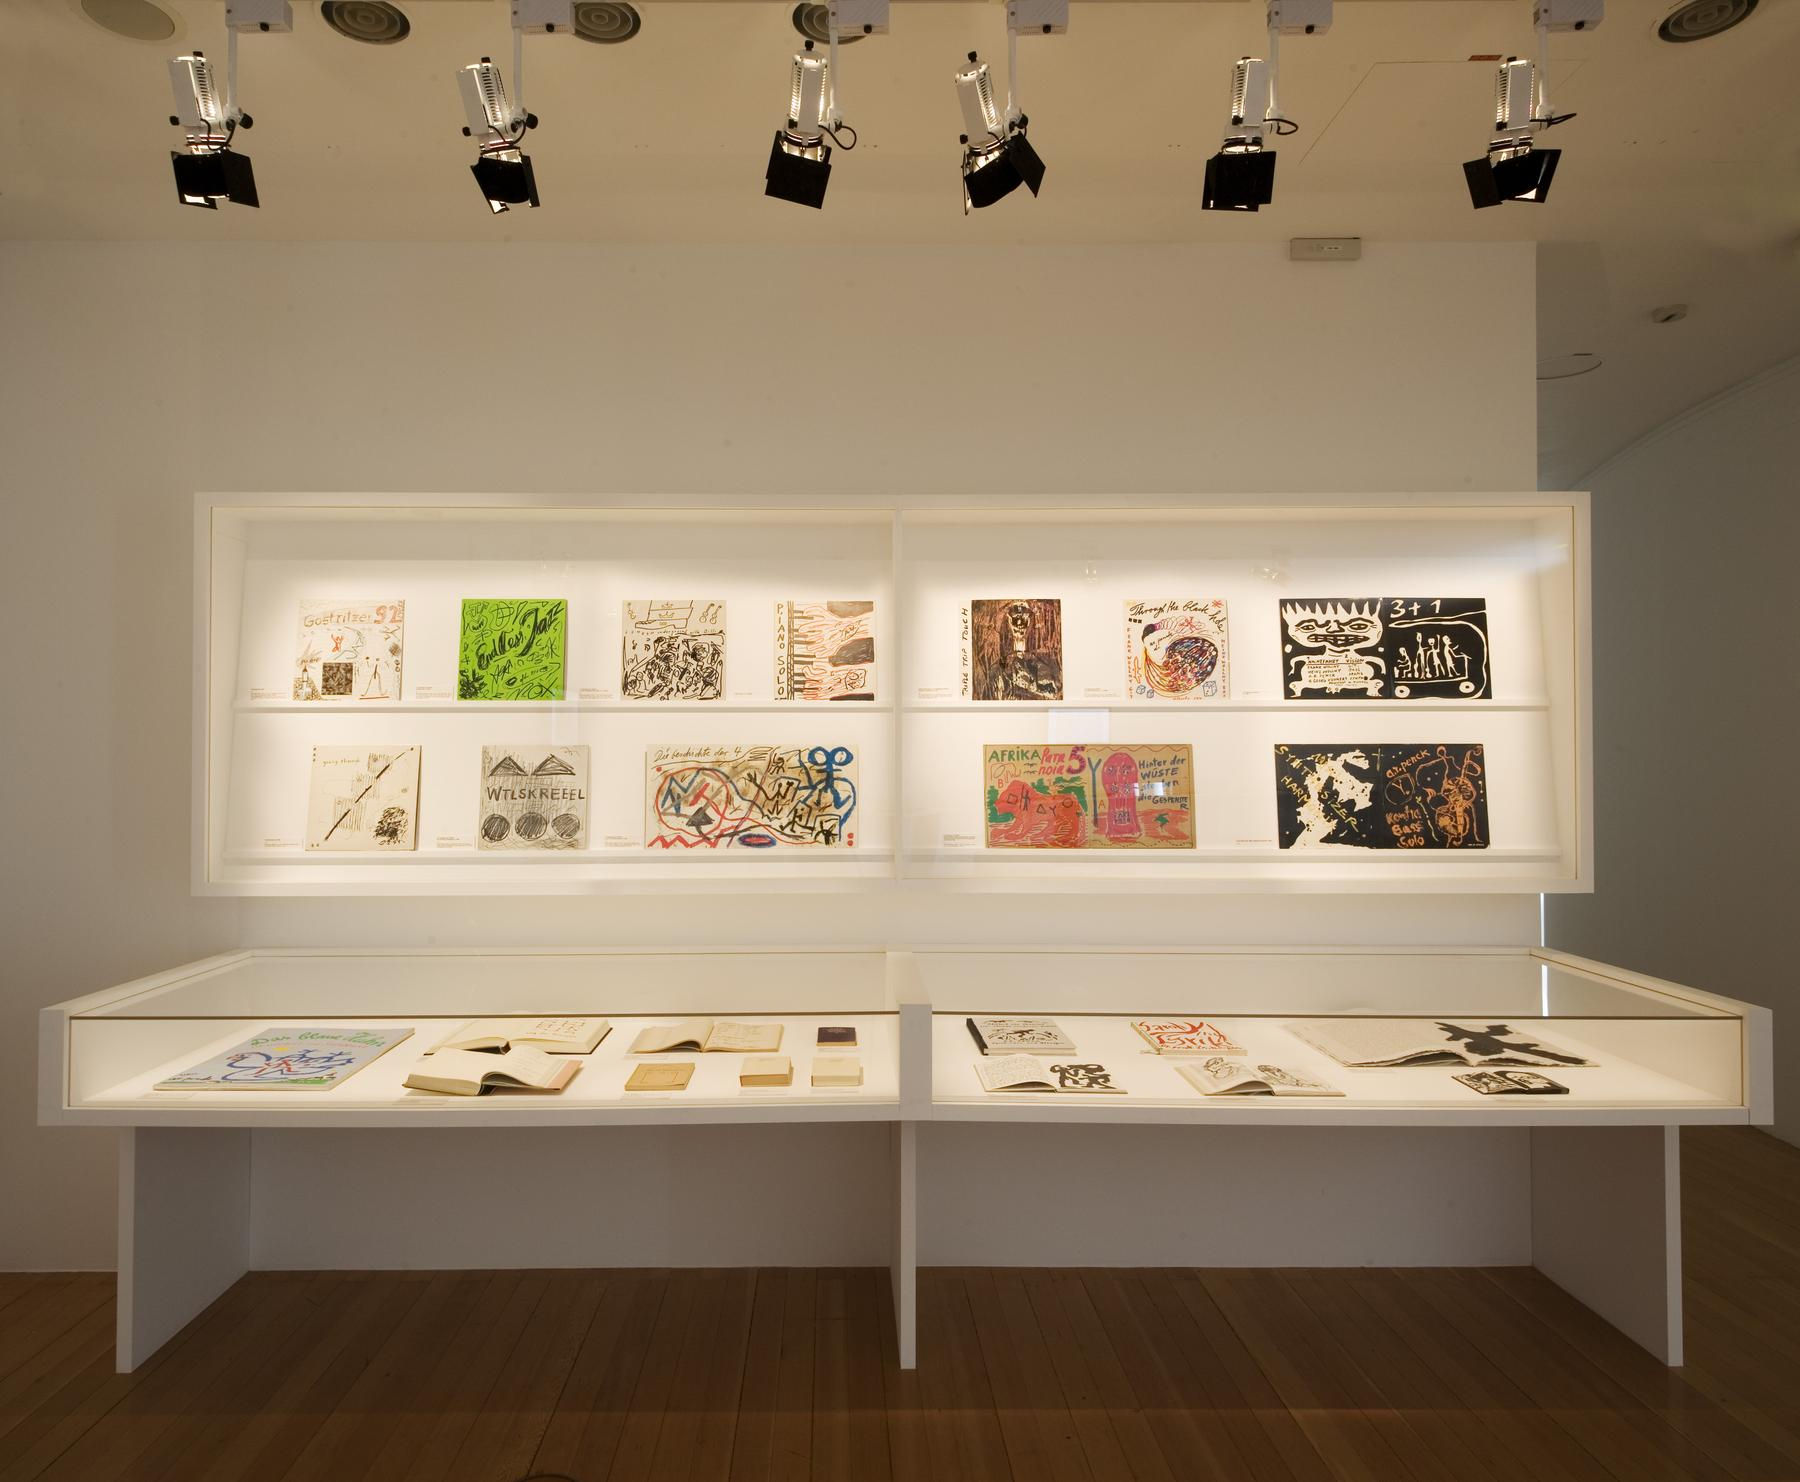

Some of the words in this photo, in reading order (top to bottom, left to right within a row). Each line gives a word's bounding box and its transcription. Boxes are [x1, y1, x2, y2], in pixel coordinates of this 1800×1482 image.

[1129, 602, 1167, 619] Through
[777, 603, 786, 650] PIANO
[776, 655, 786, 696] SOLO
[1138, 758, 1167, 769] Hinter
[1170, 755, 1186, 765] der
